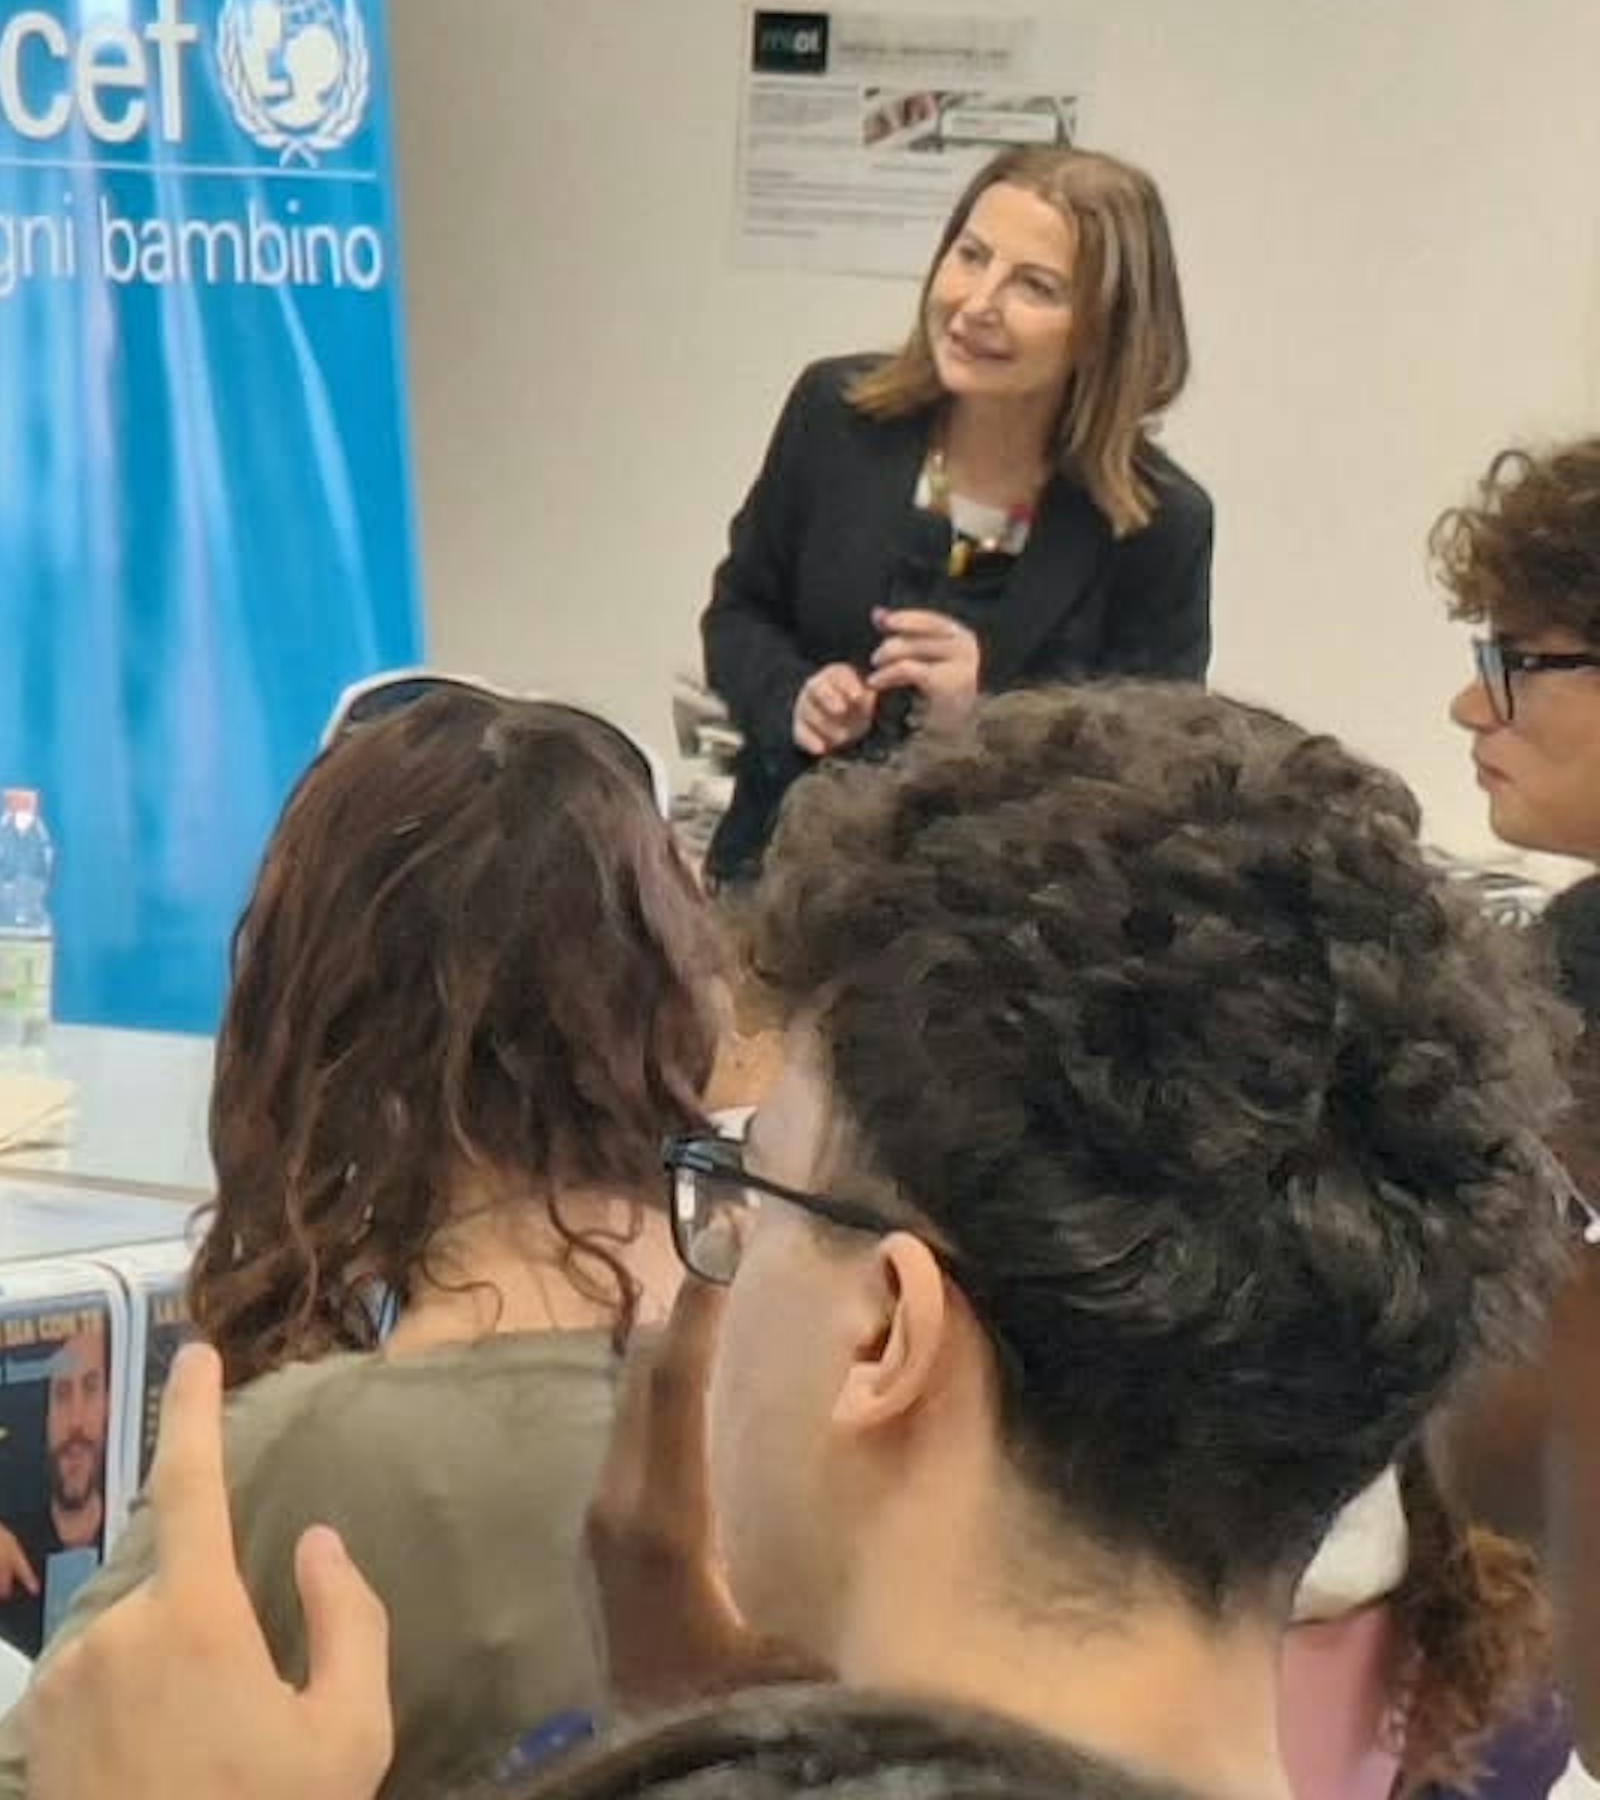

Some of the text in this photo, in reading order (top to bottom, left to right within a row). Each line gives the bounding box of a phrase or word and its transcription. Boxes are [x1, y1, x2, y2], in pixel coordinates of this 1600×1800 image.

[99, 193, 384, 290] bambino
[5, 1317, 34, 1348] SIA
[39, 1311, 75, 1342] CON
